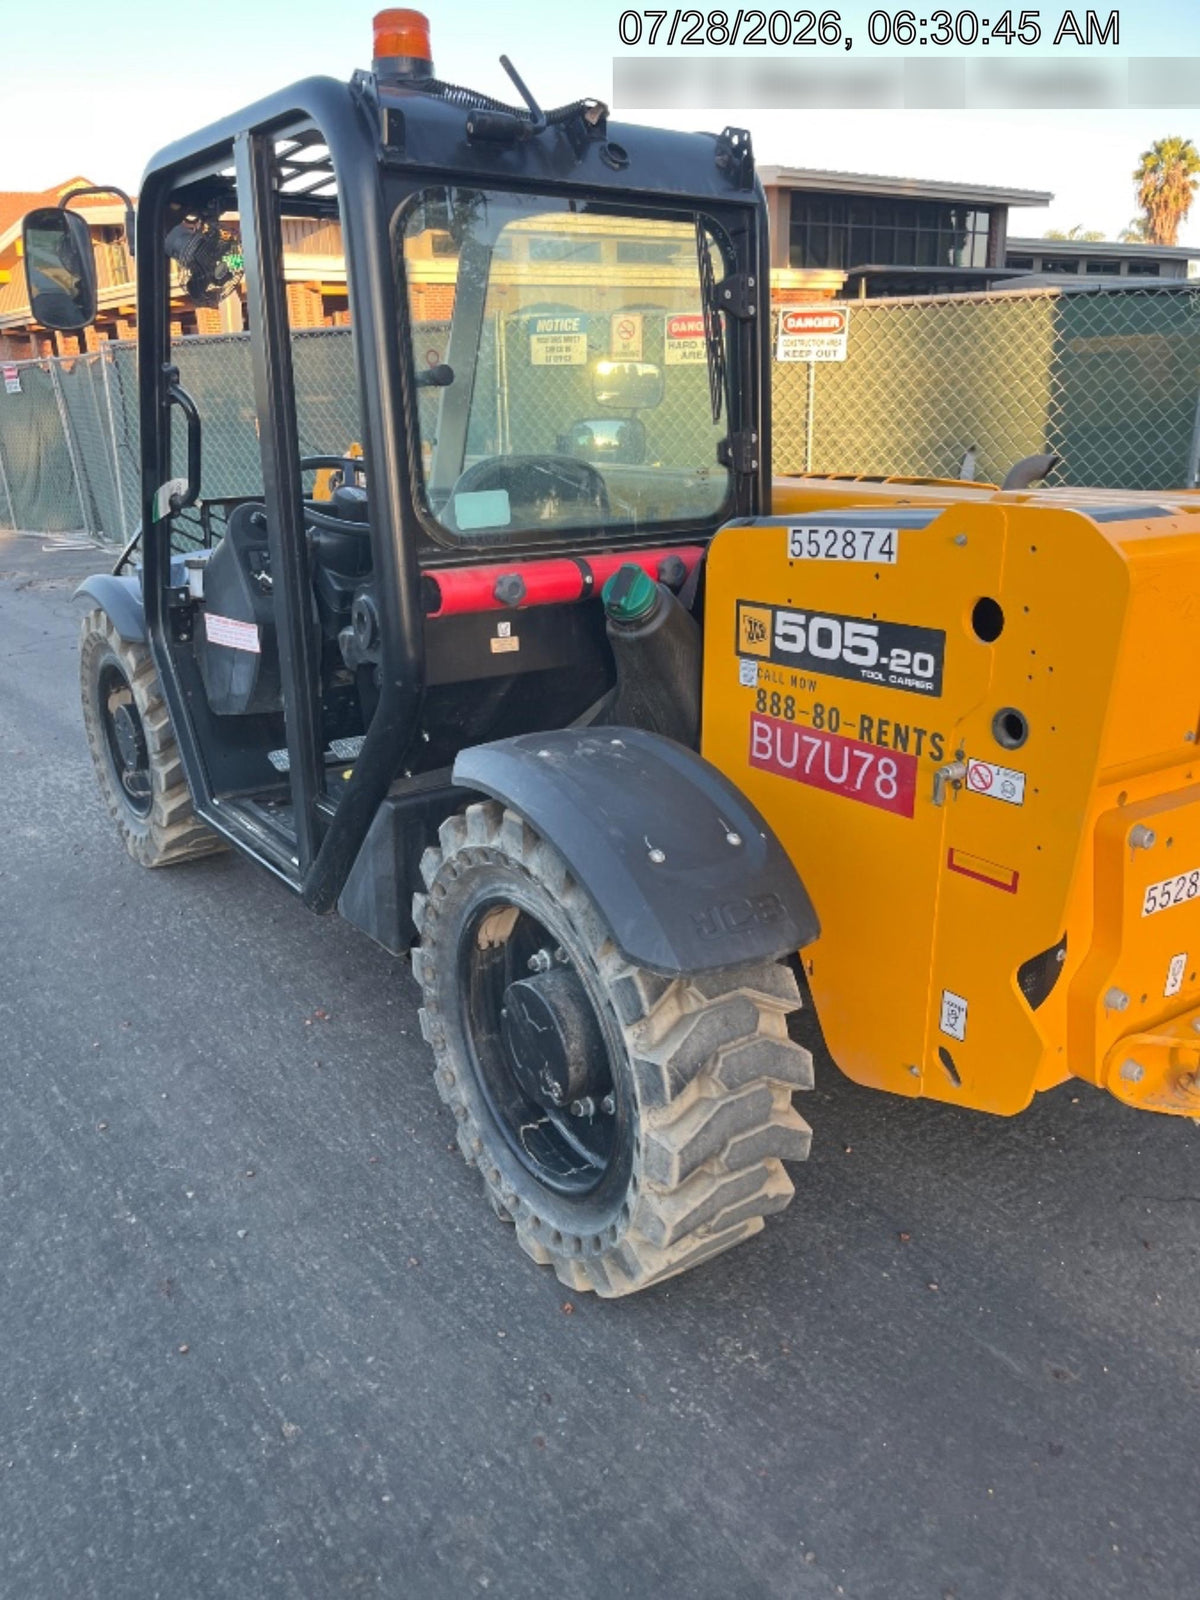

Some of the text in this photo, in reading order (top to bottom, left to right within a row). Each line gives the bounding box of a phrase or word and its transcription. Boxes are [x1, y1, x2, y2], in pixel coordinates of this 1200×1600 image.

[537, 317, 580, 333] NOTICE
[671, 320, 705, 333] DANG
[787, 317, 839, 328] DANGER
[668, 340, 698, 350] HARD
[784, 349, 838, 358] KEEP OUT
[790, 529, 896, 562] 552874
[757, 667, 784, 685] CALL
[791, 675, 816, 692] NOW
[860, 669, 887, 682] TOOL
[756, 688, 945, 761] 888-80-RENTS
[752, 720, 898, 800] BU7U78
